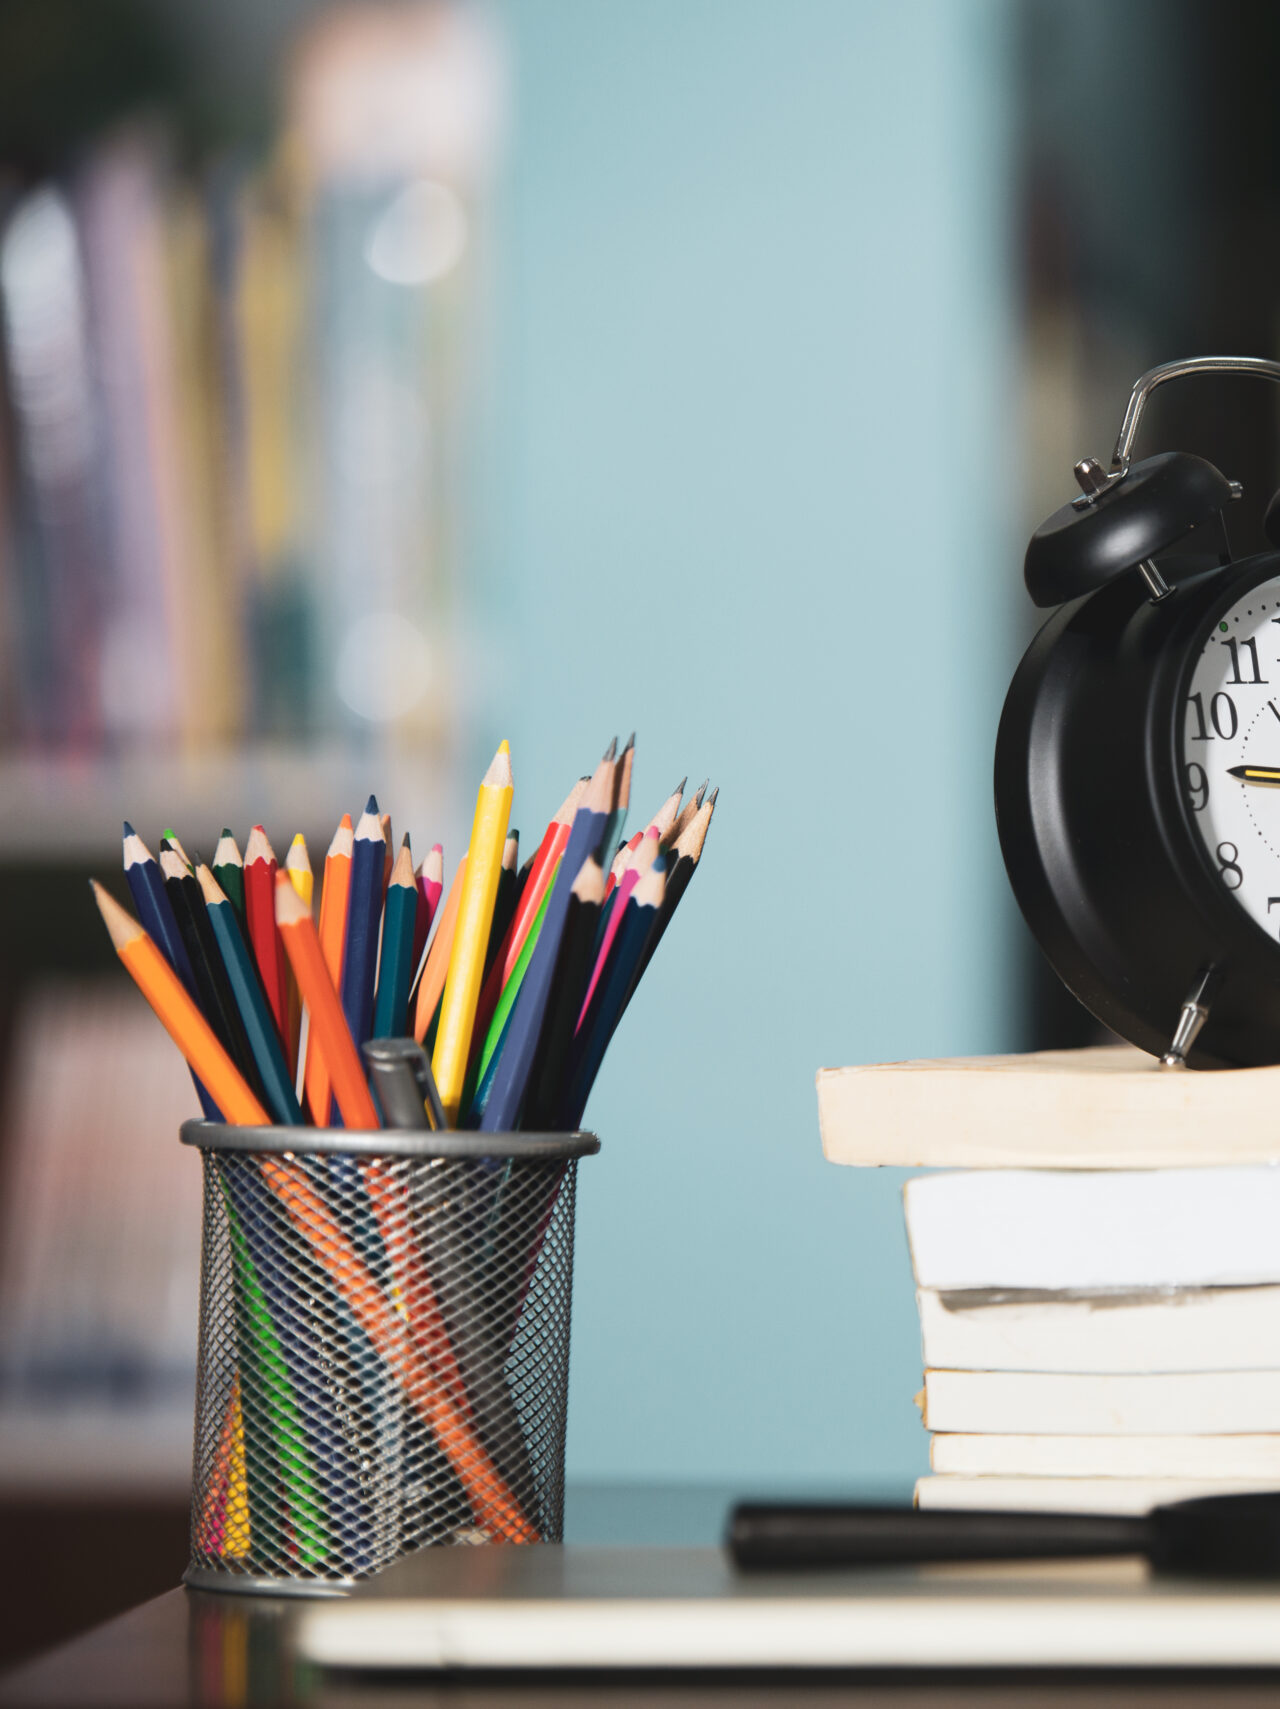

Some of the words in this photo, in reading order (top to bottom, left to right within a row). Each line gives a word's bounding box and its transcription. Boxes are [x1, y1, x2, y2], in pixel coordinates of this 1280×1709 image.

[1221, 636, 1269, 685] 11
[1187, 692, 1238, 740] 10
[1186, 762, 1209, 812] 9
[1216, 841, 1243, 891] 8
